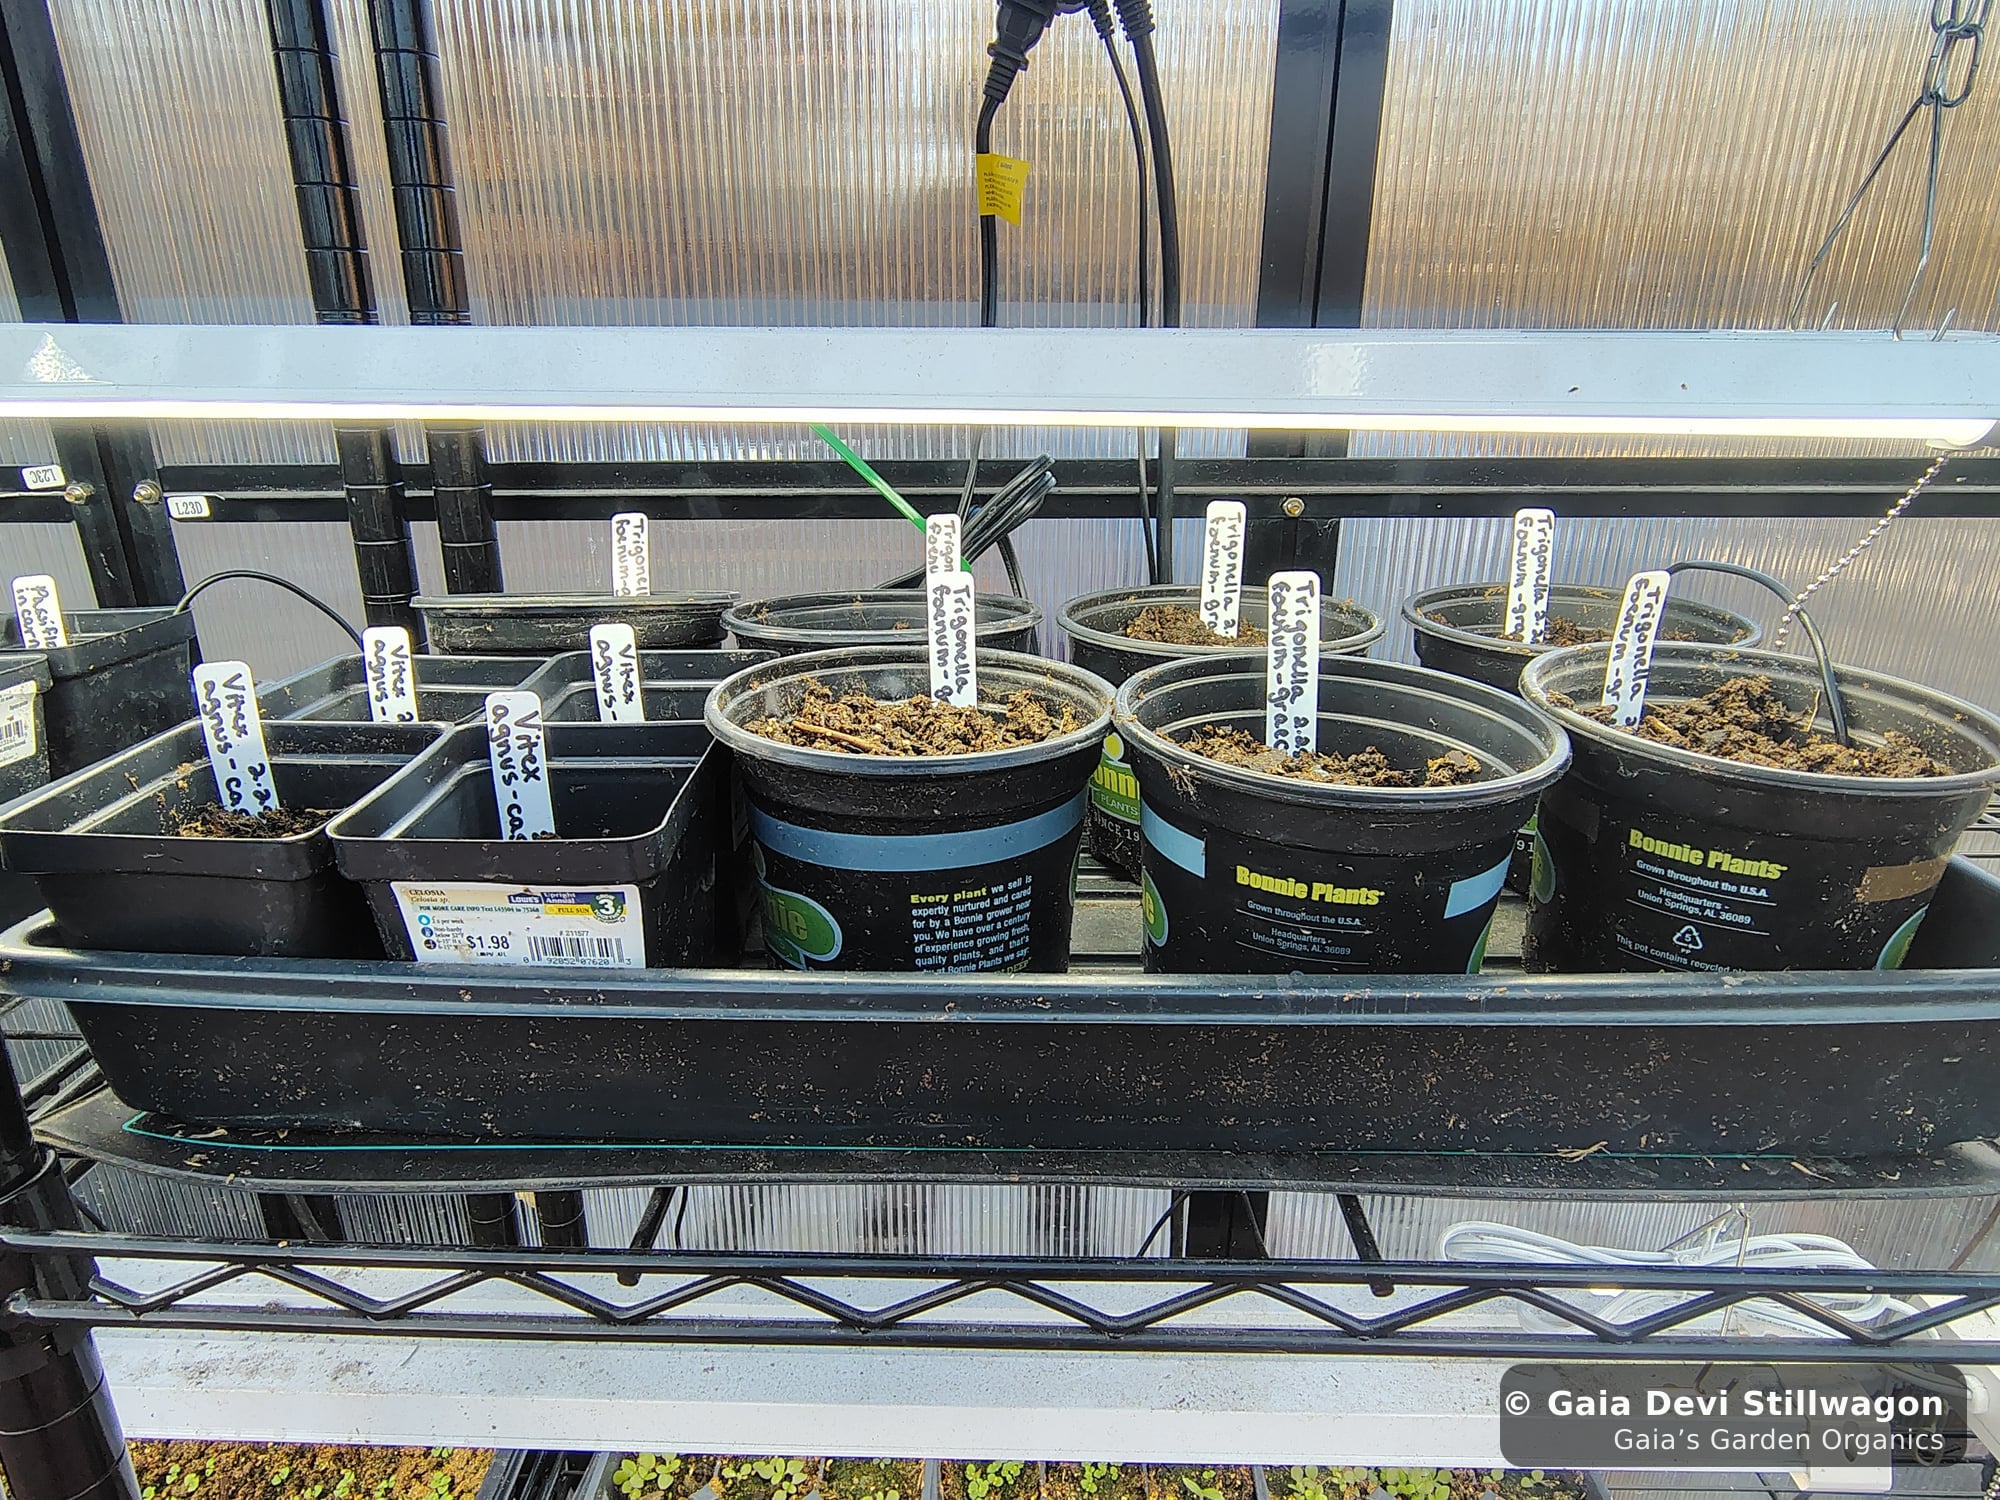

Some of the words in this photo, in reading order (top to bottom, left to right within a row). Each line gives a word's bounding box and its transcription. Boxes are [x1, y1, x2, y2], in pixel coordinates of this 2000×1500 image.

[29, 468, 57, 484] L23C
[174, 501, 204, 515] L23D
[949, 584, 971, 695] Trigonella
[1283, 579, 1315, 704] Trigonella
[1629, 585, 1661, 702] Trigonella
[391, 644, 409, 698] Vitex
[618, 643, 636, 704] Vitex
[222, 672, 249, 738] Vitex
[513, 709, 543, 783] Vitex
[1100, 793, 1139, 816] PLANTS
[1628, 828, 1704, 865] Bonnie
[1707, 849, 1783, 880] Plants
[910, 894, 949, 903] Every
[953, 887, 987, 902] plant
[991, 884, 1004, 895] we
[1007, 877, 1023, 890] sell
[1025, 874, 1033, 884] is
[1236, 865, 1309, 899] Bonnie
[1311, 882, 1381, 905] Plants
[1636, 858, 1665, 876] Grown
[1666, 867, 1719, 889] throughout
[1721, 881, 1737, 893] the
[544, 892, 577, 900] Upright
[598, 899, 615, 915] 3
[911, 905, 949, 918] expertly
[953, 898, 990, 913] nurtured
[993, 893, 1009, 906] and
[1011, 886, 1032, 901] cared
[1637, 889, 1663, 905] Union
[1664, 897, 1702, 916] Springs,
[1703, 907, 1717, 918] AL
[1719, 911, 1752, 925] 36089
[1659, 887, 1722, 910] Headquarters
[912, 919, 925, 929] for
[929, 918, 940, 932] by
[944, 919, 951, 927] a
[954, 913, 983, 926] Bonnie
[986, 905, 1014, 921] grower
[1247, 900, 1273, 914] Grown
[1274, 907, 1320, 922] throughout
[1322, 915, 1336, 924] the
[913, 931, 934, 943] you.
[935, 930, 950, 940] We
[952, 926, 974, 938] have
[975, 923, 995, 934] over
[1003, 911, 1031, 928] century
[1271, 927, 1326, 944] Headquarters
[466, 935, 510, 951] $1.98
[914, 943, 925, 954] of
[925, 939, 975, 954] experience
[977, 931, 1009, 948] growing
[915, 955, 947, 968] quality
[953, 950, 984, 964] plants,
[988, 944, 1004, 956] and
[1252, 932, 1275, 945] Union
[1276, 938, 1310, 952] Springs,
[1311, 944, 1322, 953] AL
[1324, 945, 1351, 955] 36089
[1615, 933, 1632, 947] This
[1634, 942, 1649, 954] pot
[1649, 947, 1688, 965] contains
[948, 962, 977, 974] Bonnie
[978, 957, 1003, 969] Plants
[1004, 953, 1015, 962] we
